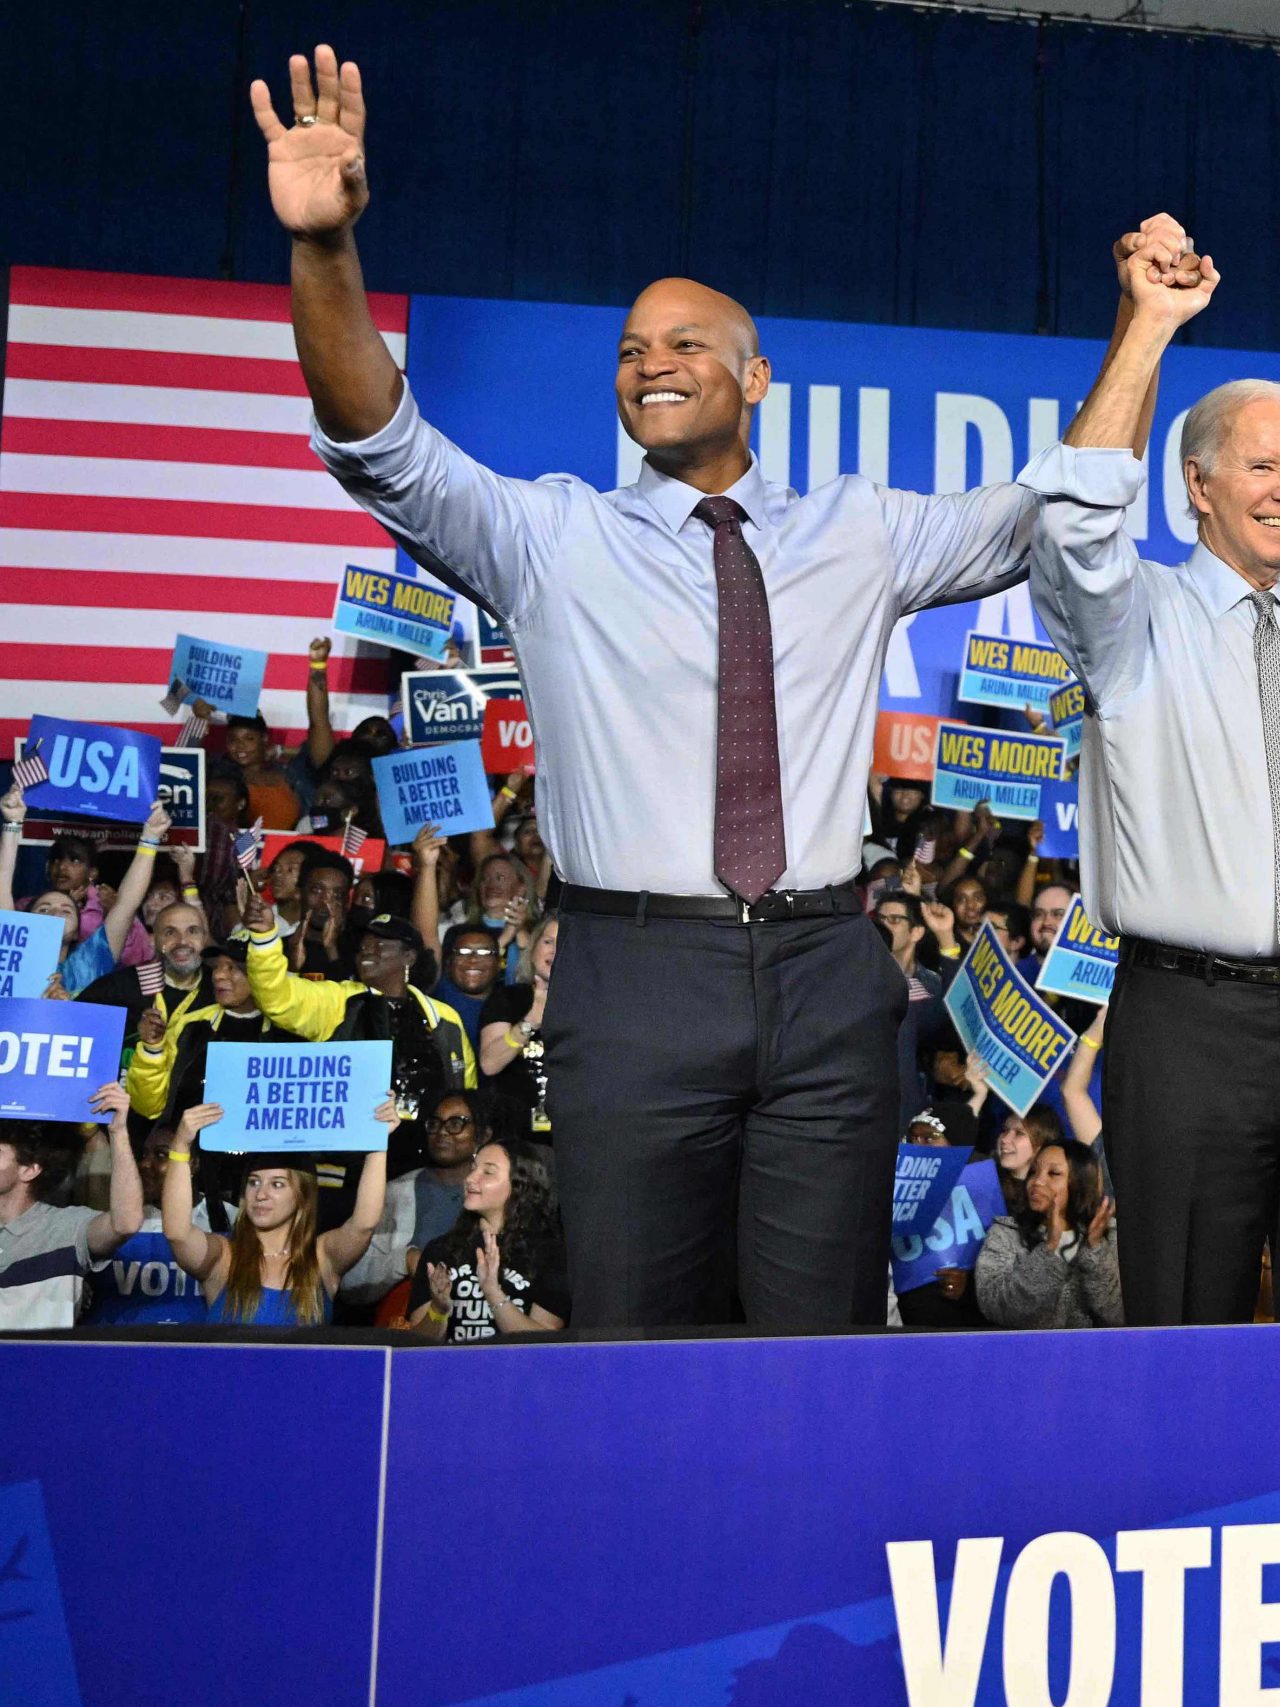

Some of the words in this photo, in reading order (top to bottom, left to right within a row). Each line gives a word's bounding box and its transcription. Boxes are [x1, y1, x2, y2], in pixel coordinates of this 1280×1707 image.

[346, 569, 390, 606] WES
[392, 582, 454, 625] MOORE
[355, 611, 393, 634] ARUNA
[396, 623, 434, 648] MILLER
[188, 644, 242, 670] BUILDING
[970, 638, 1010, 670] WES
[185, 661, 193, 676] A
[193, 664, 239, 686] BETTER
[980, 678, 1014, 697] ARUNA
[413, 689, 448, 701] Chris
[1051, 684, 1086, 722] WES
[414, 699, 468, 724] Van
[890, 722, 935, 765] US
[941, 731, 986, 769] WES
[989, 739, 1062, 779] MOORE
[49, 734, 140, 799] USA
[392, 755, 457, 784] BUILDING
[398, 786, 407, 805] A
[408, 776, 461, 803] BETTER
[954, 779, 992, 801] ARUNA
[995, 785, 1038, 807] MILLER
[404, 797, 464, 826] AMERICA
[971, 932, 1005, 999] WES
[991, 979, 1067, 1071] MOORE
[247, 1055, 352, 1079] BUILDING
[245, 1082, 260, 1104] A
[267, 1081, 348, 1104] BETTER
[245, 1106, 345, 1130] AMERICA
